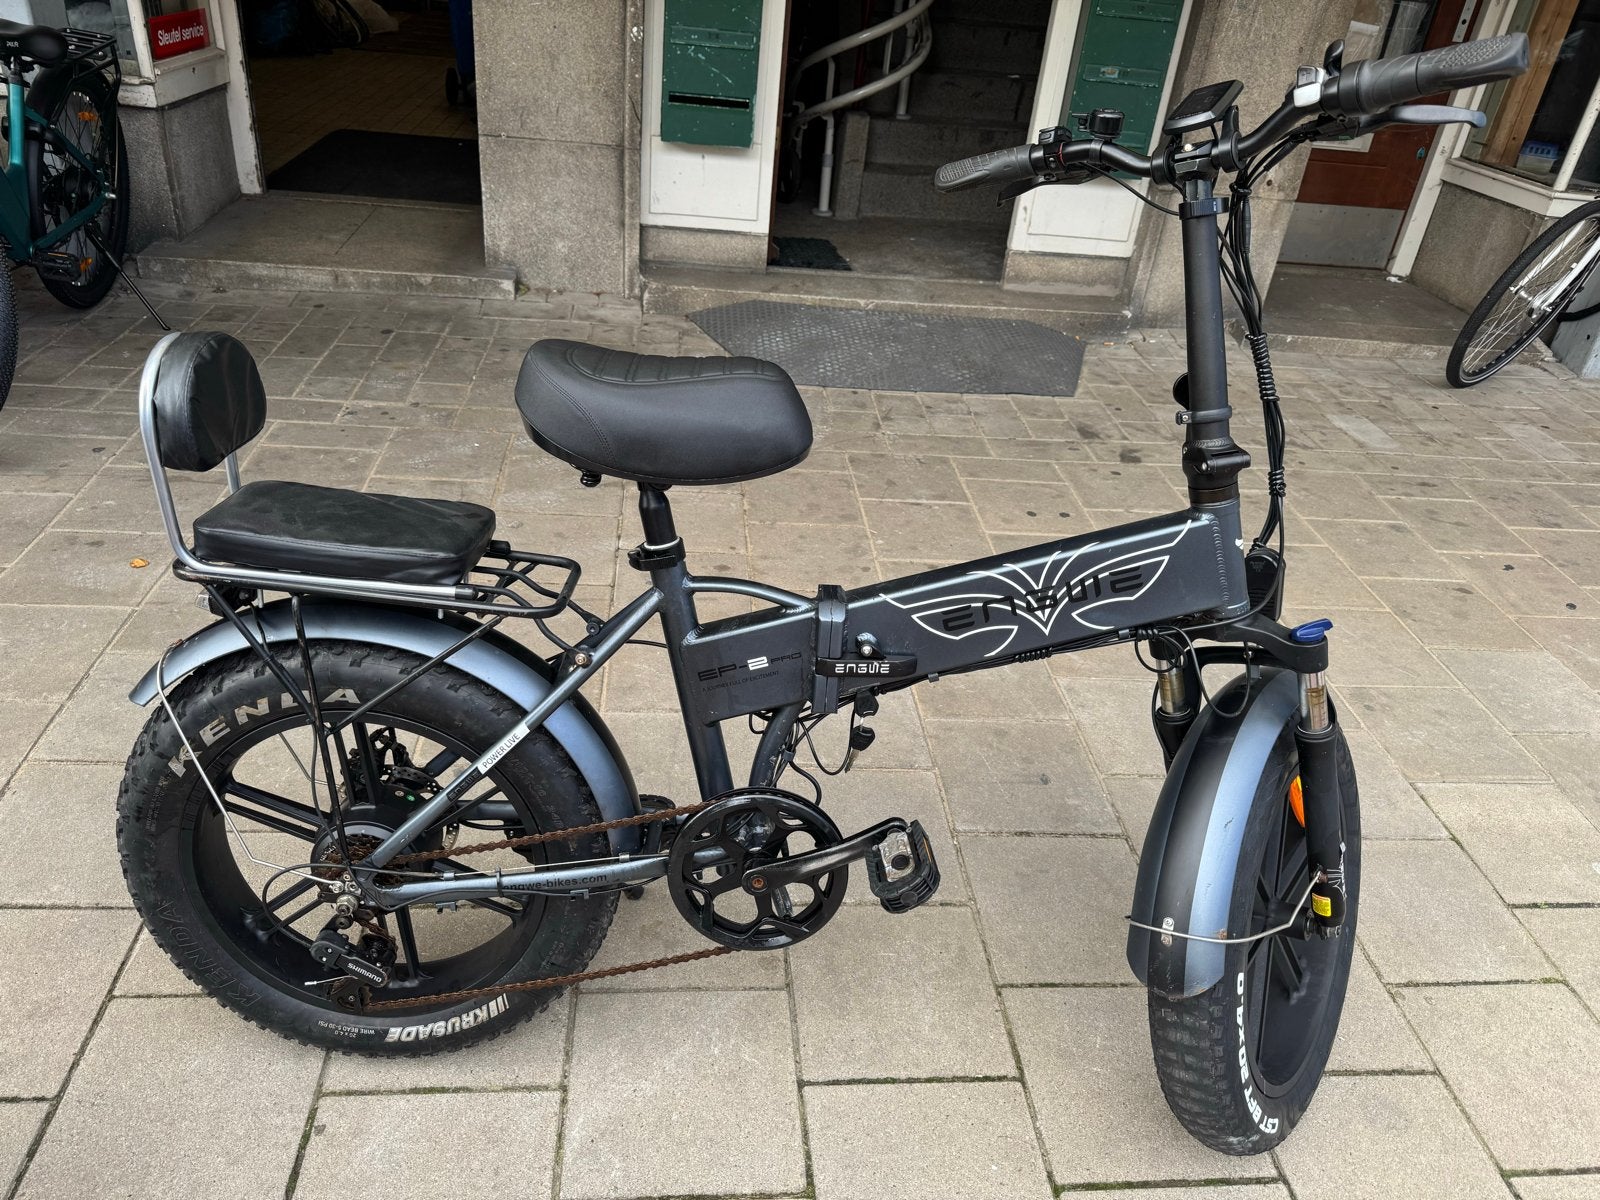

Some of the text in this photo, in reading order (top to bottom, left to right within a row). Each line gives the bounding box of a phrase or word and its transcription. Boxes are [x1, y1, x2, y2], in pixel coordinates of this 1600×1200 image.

[158, 23, 204, 46] Sleutel service
[698, 656, 769, 681] EP-2
[834, 662, 890, 674] ENGWE
[482, 732, 521, 769] POWER LIVE
[155, 899, 262, 1008] KENDA
[347, 962, 382, 983] SHIMANO
[318, 1020, 329, 1028] PSI
[342, 1025, 359, 1033] BEAD
[384, 1006, 490, 1043] KRUSADE
[1259, 1115, 1279, 1134] CST
